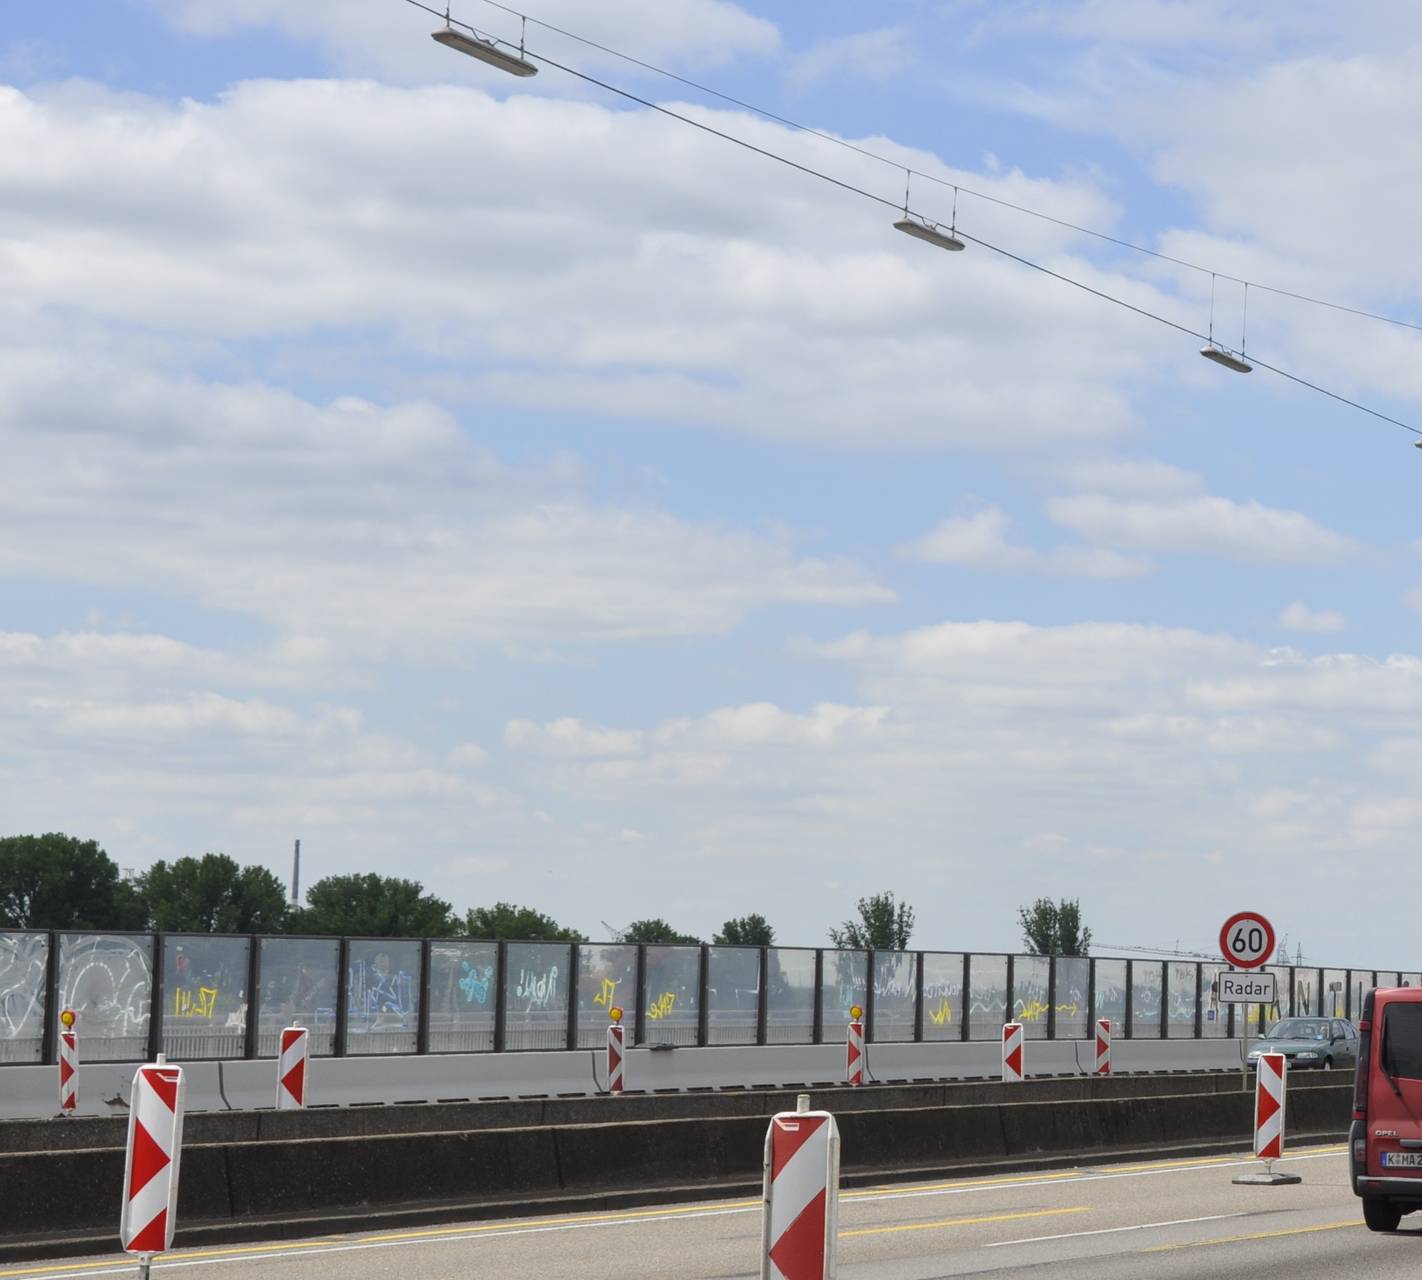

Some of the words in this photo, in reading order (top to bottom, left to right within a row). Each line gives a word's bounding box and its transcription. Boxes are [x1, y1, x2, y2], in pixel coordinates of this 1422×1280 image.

[1232, 927, 1262, 953] 60
[1224, 980, 1271, 995] Radar
[1375, 1129, 1398, 1137] OPEL
